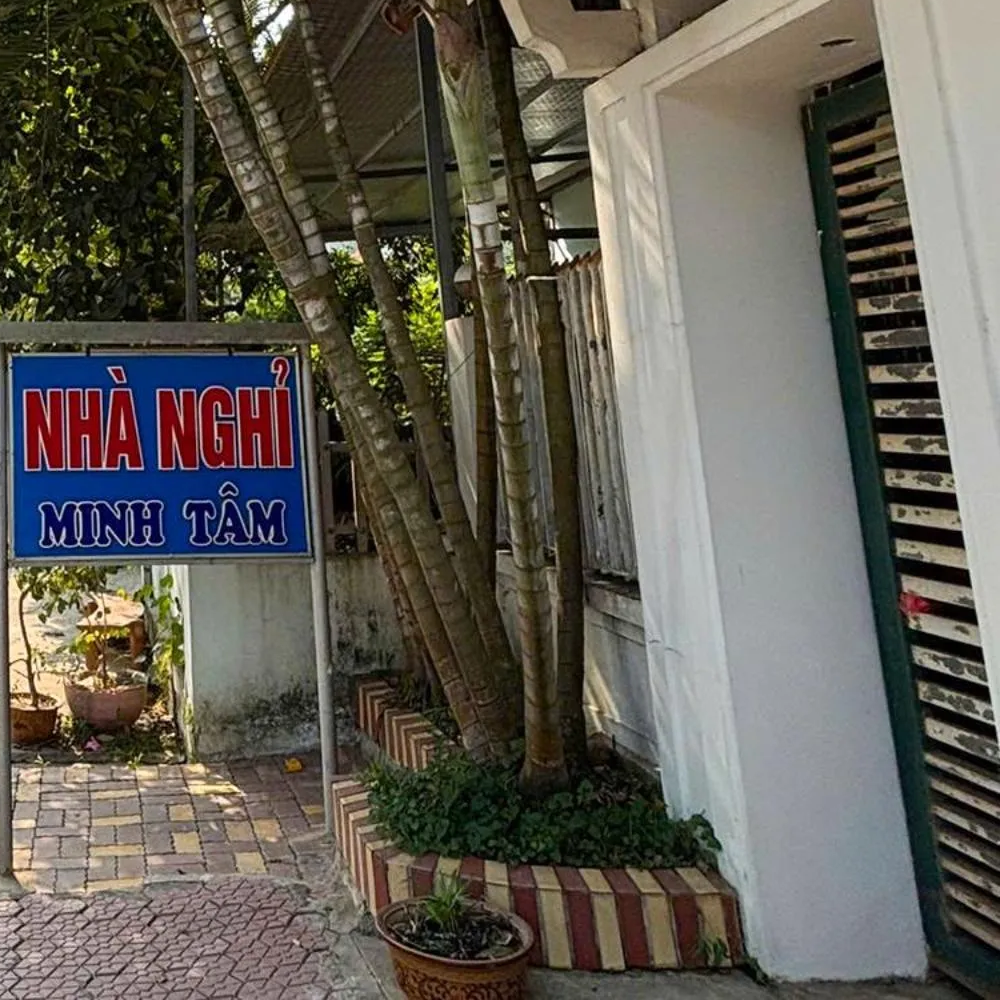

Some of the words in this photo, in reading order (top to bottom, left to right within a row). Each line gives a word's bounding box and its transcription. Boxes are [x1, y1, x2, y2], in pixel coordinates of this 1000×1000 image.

[23, 366, 144, 471] NHÀ
[156, 357, 294, 470] NGHỈ
[39, 500, 165, 548] MINH
[183, 482, 288, 545] TÂM
